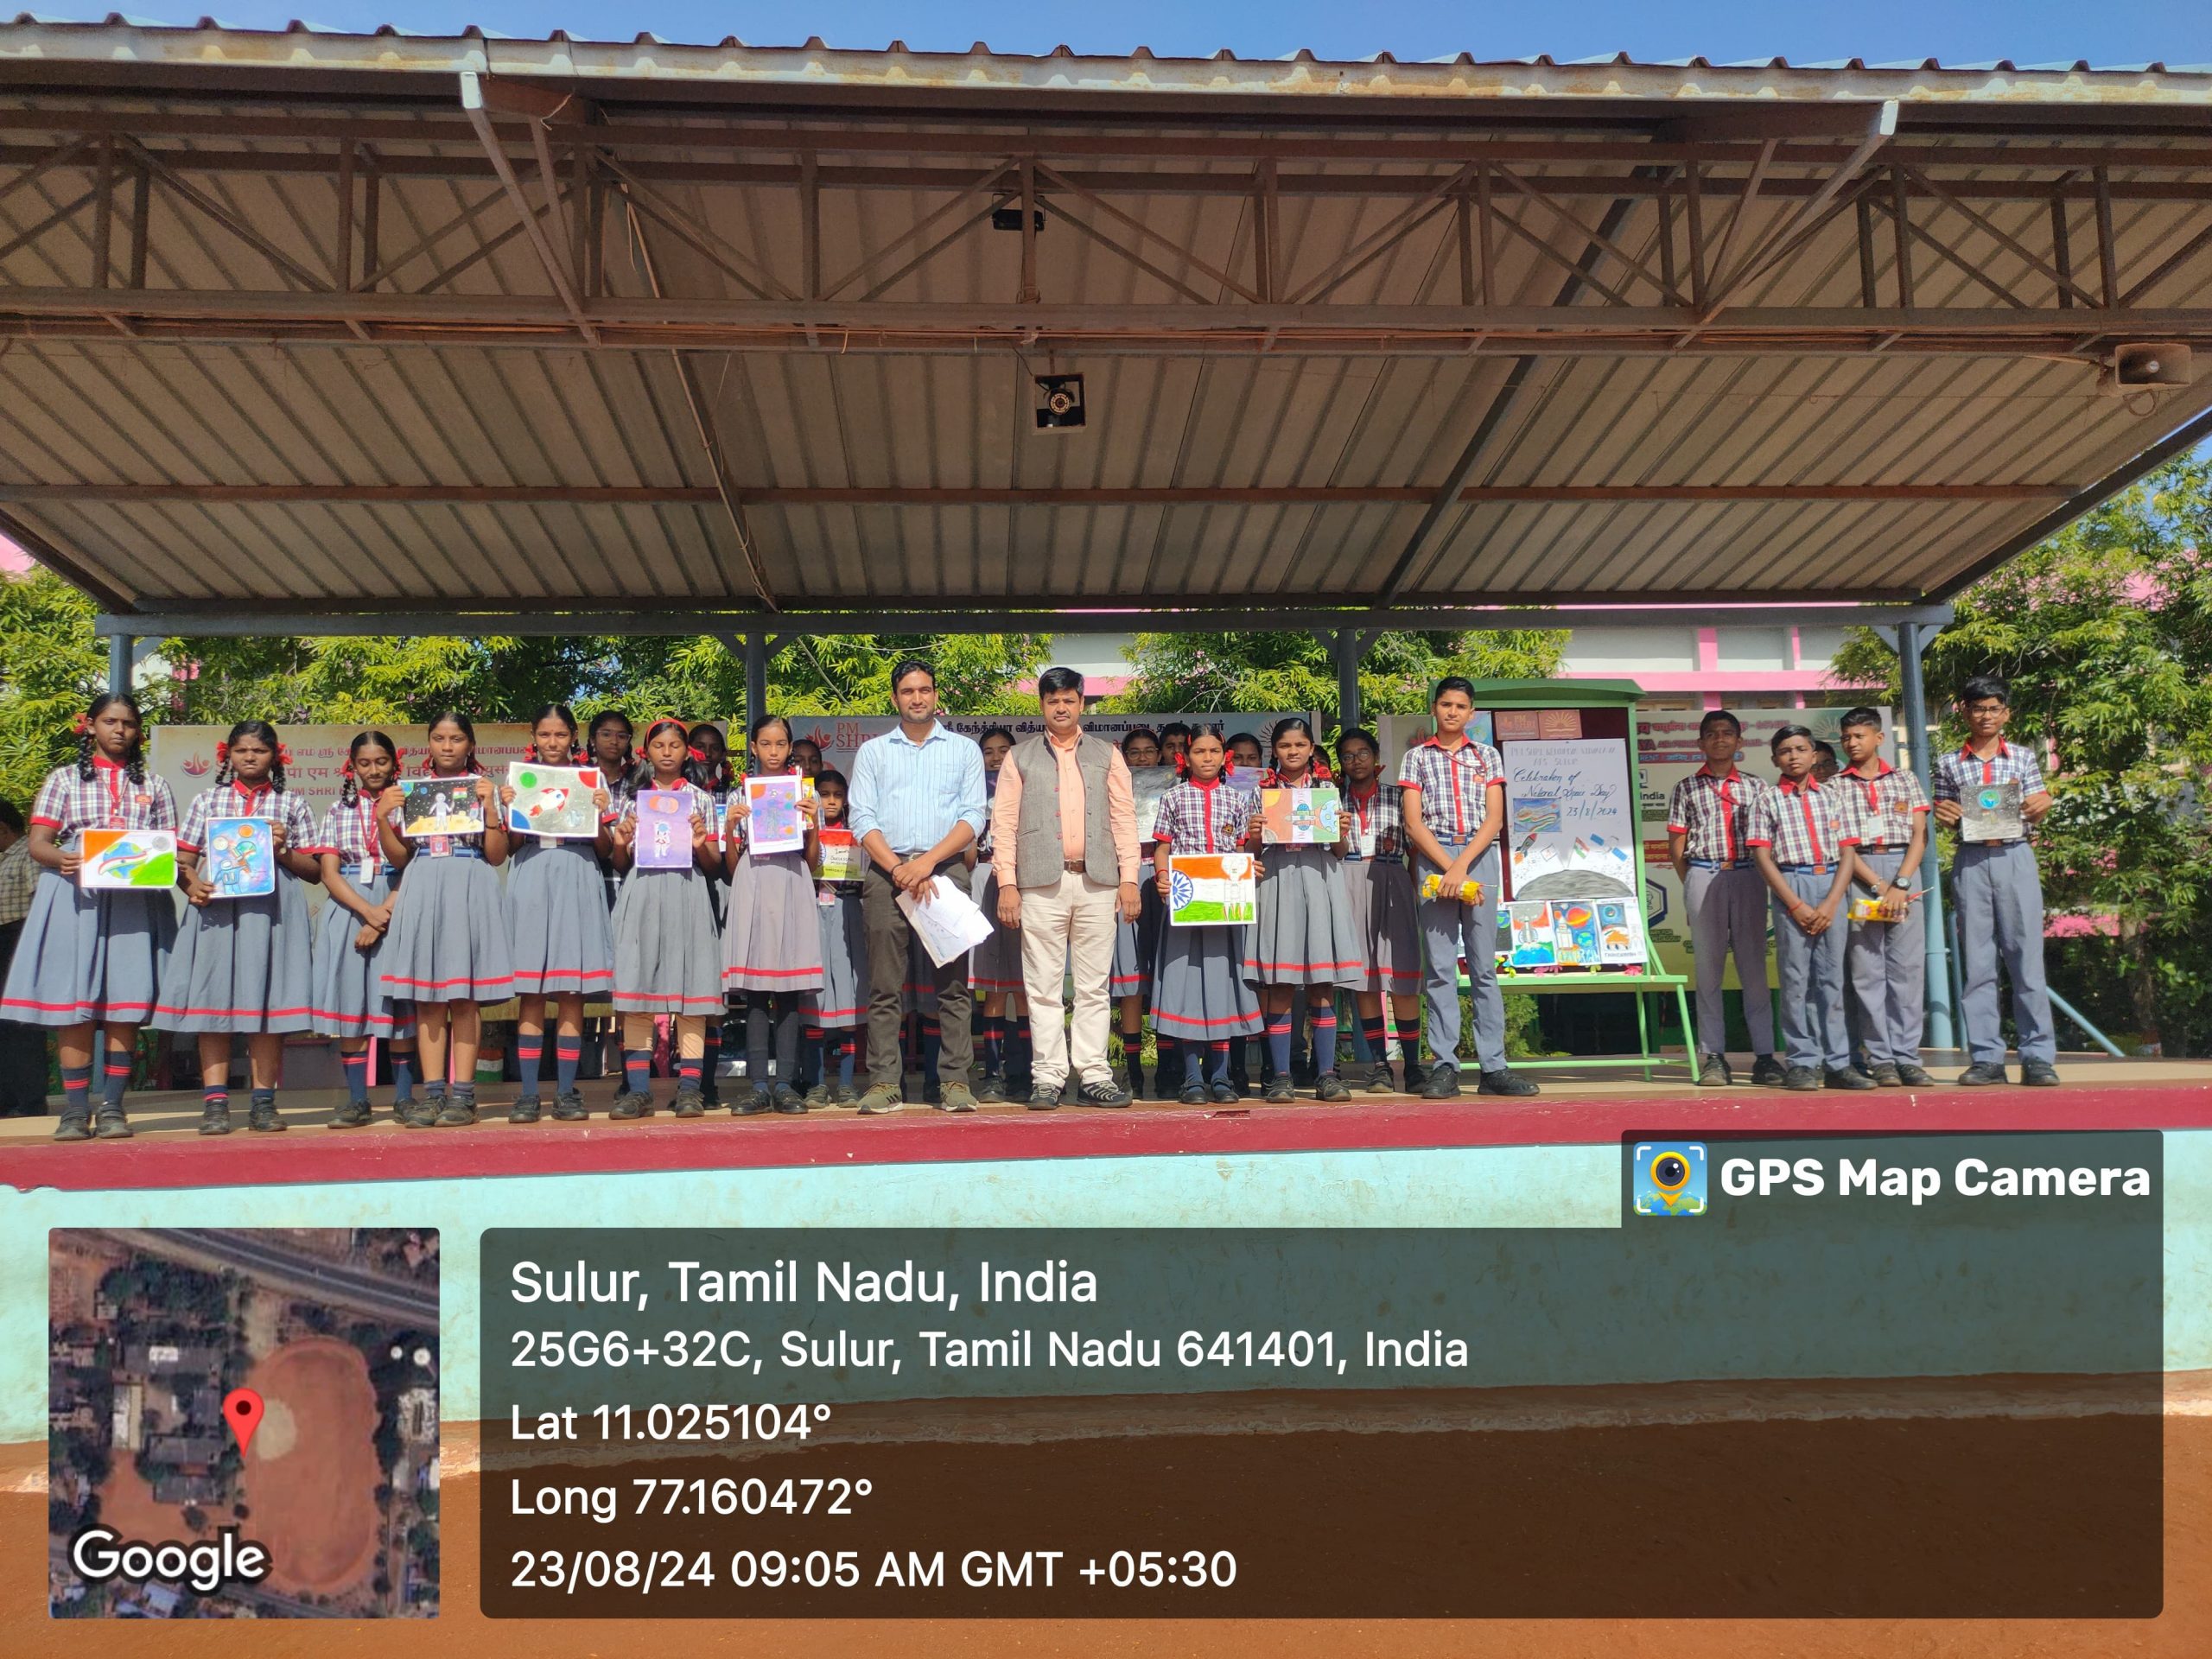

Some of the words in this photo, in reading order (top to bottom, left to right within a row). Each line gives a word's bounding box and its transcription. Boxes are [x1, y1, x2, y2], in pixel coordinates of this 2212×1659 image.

[836, 722, 859, 734] PM
[1568, 771, 1583, 785] of
[308, 787, 335, 796] SHRI
